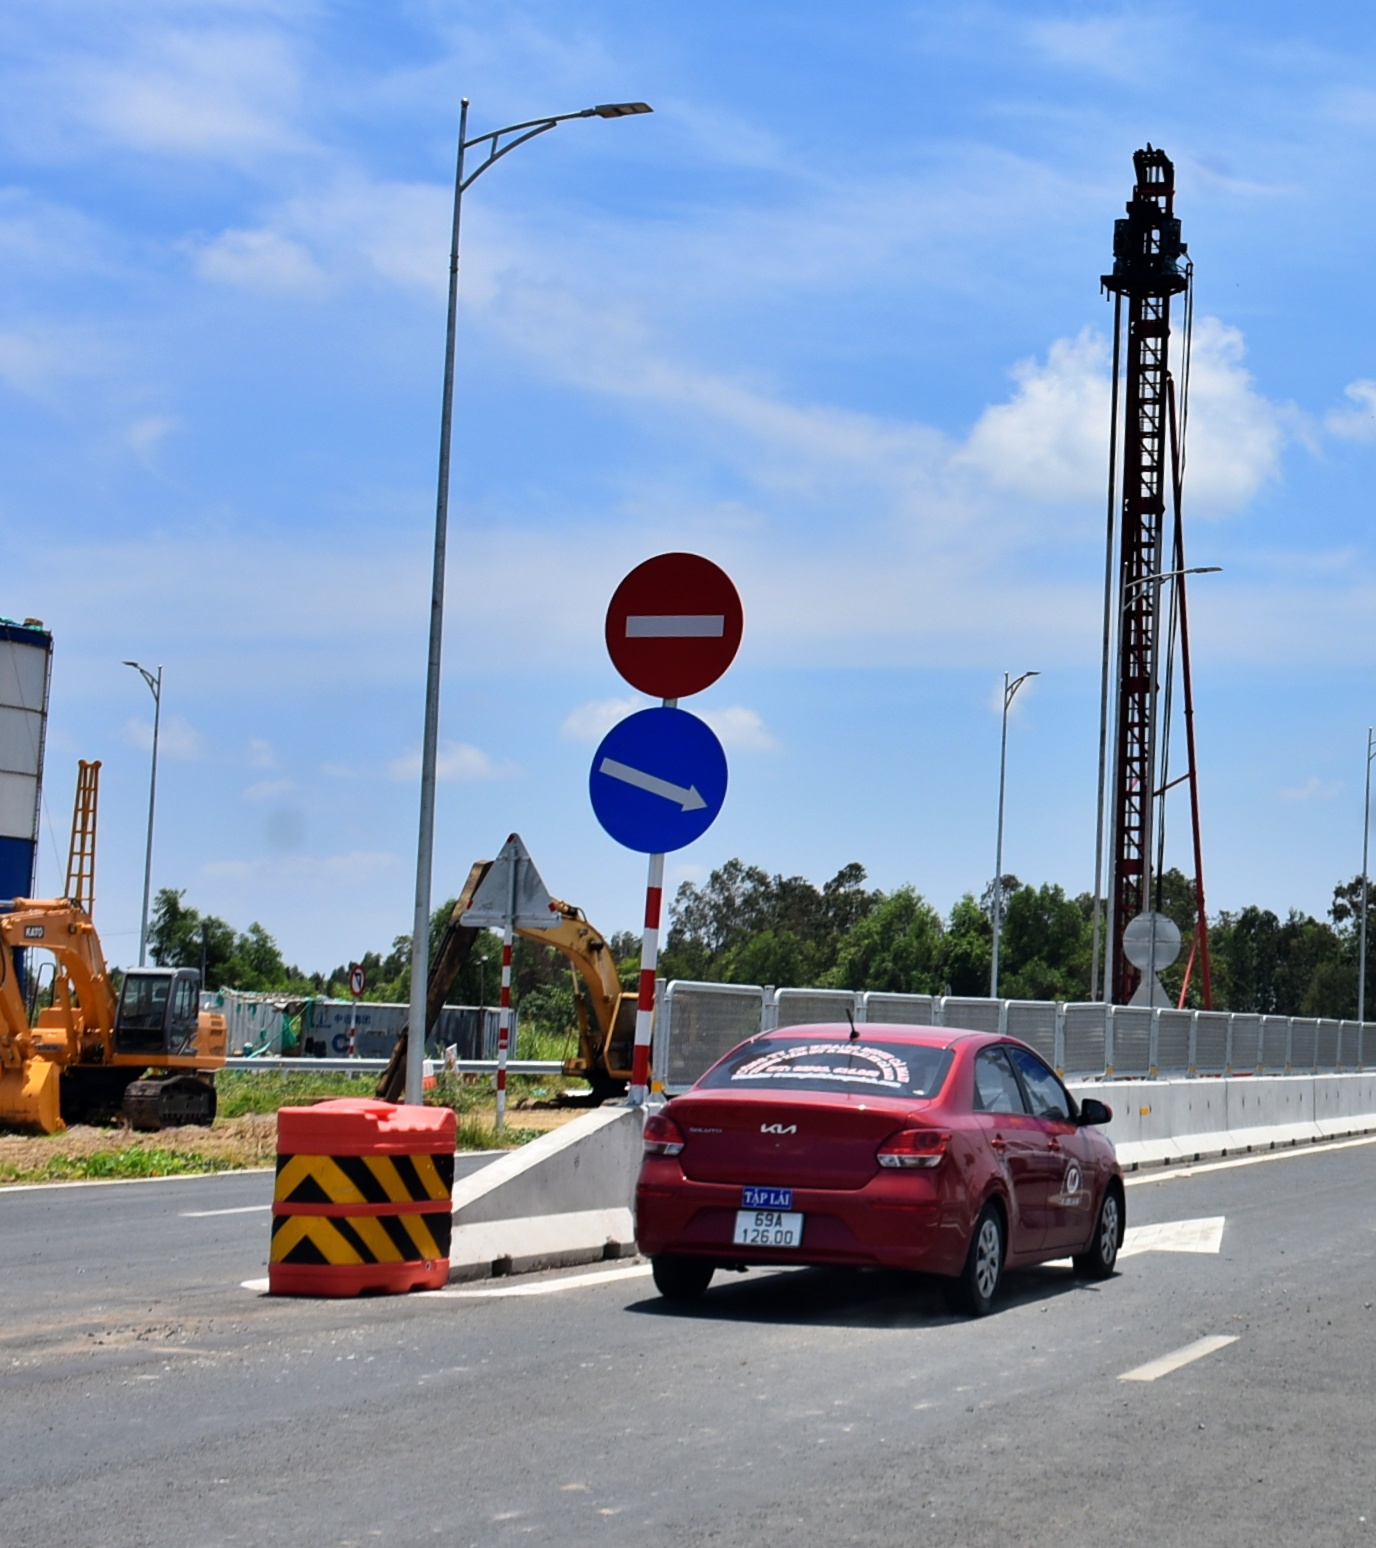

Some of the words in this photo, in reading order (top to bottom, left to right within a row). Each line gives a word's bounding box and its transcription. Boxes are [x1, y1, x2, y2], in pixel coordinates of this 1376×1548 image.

[25, 926, 44, 938] KATO
[744, 1188, 768, 1207] TẬP
[769, 1190, 790, 1206] LÁI
[754, 1212, 783, 1228] 69A
[742, 1228, 794, 1245] 126.00
